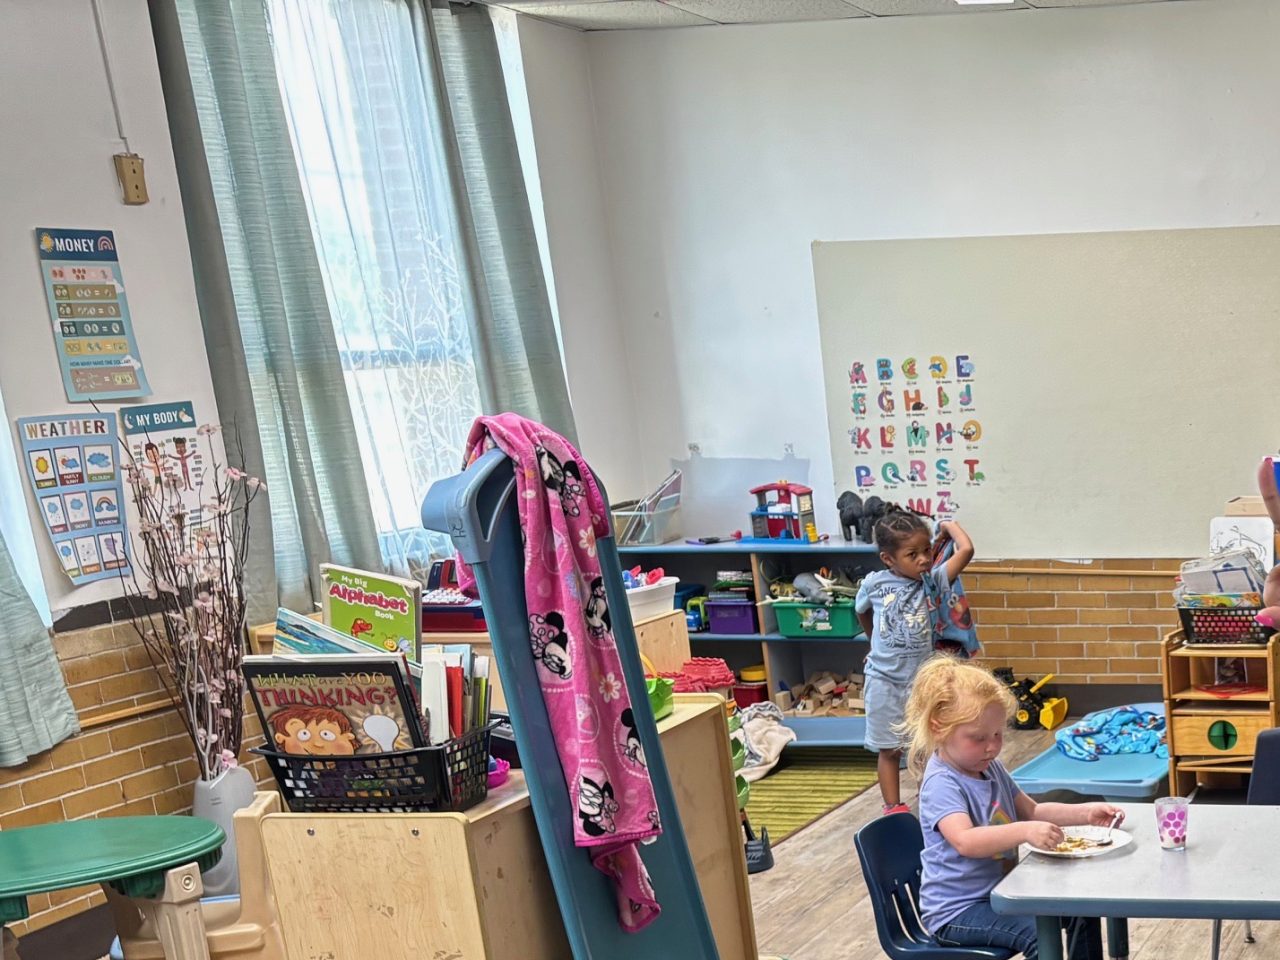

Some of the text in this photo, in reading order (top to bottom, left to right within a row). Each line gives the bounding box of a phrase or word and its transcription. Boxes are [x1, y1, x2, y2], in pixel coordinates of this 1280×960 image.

[54, 237, 95, 253] MONEY
[850, 362, 867, 384] A
[877, 358, 893, 380] B
[956, 355, 971, 377] E
[903, 389, 921, 411] H
[136, 410, 178, 426] MY BODY
[26, 420, 106, 439] WEATHER
[856, 427, 872, 449] K
[880, 426, 894, 448] L
[906, 425, 926, 447] M
[935, 422, 953, 444] N
[855, 465, 871, 487] P
[909, 460, 927, 481] R
[935, 459, 950, 480] S
[963, 459, 979, 481] T
[908, 491, 951, 519] W Z
[342, 575, 368, 588] My Big
[329, 582, 408, 615] Alphabet
[375, 610, 395, 620] Book
[257, 672, 317, 687] WHAT
[318, 678, 344, 686] are
[256, 685, 398, 707] THINKING?
